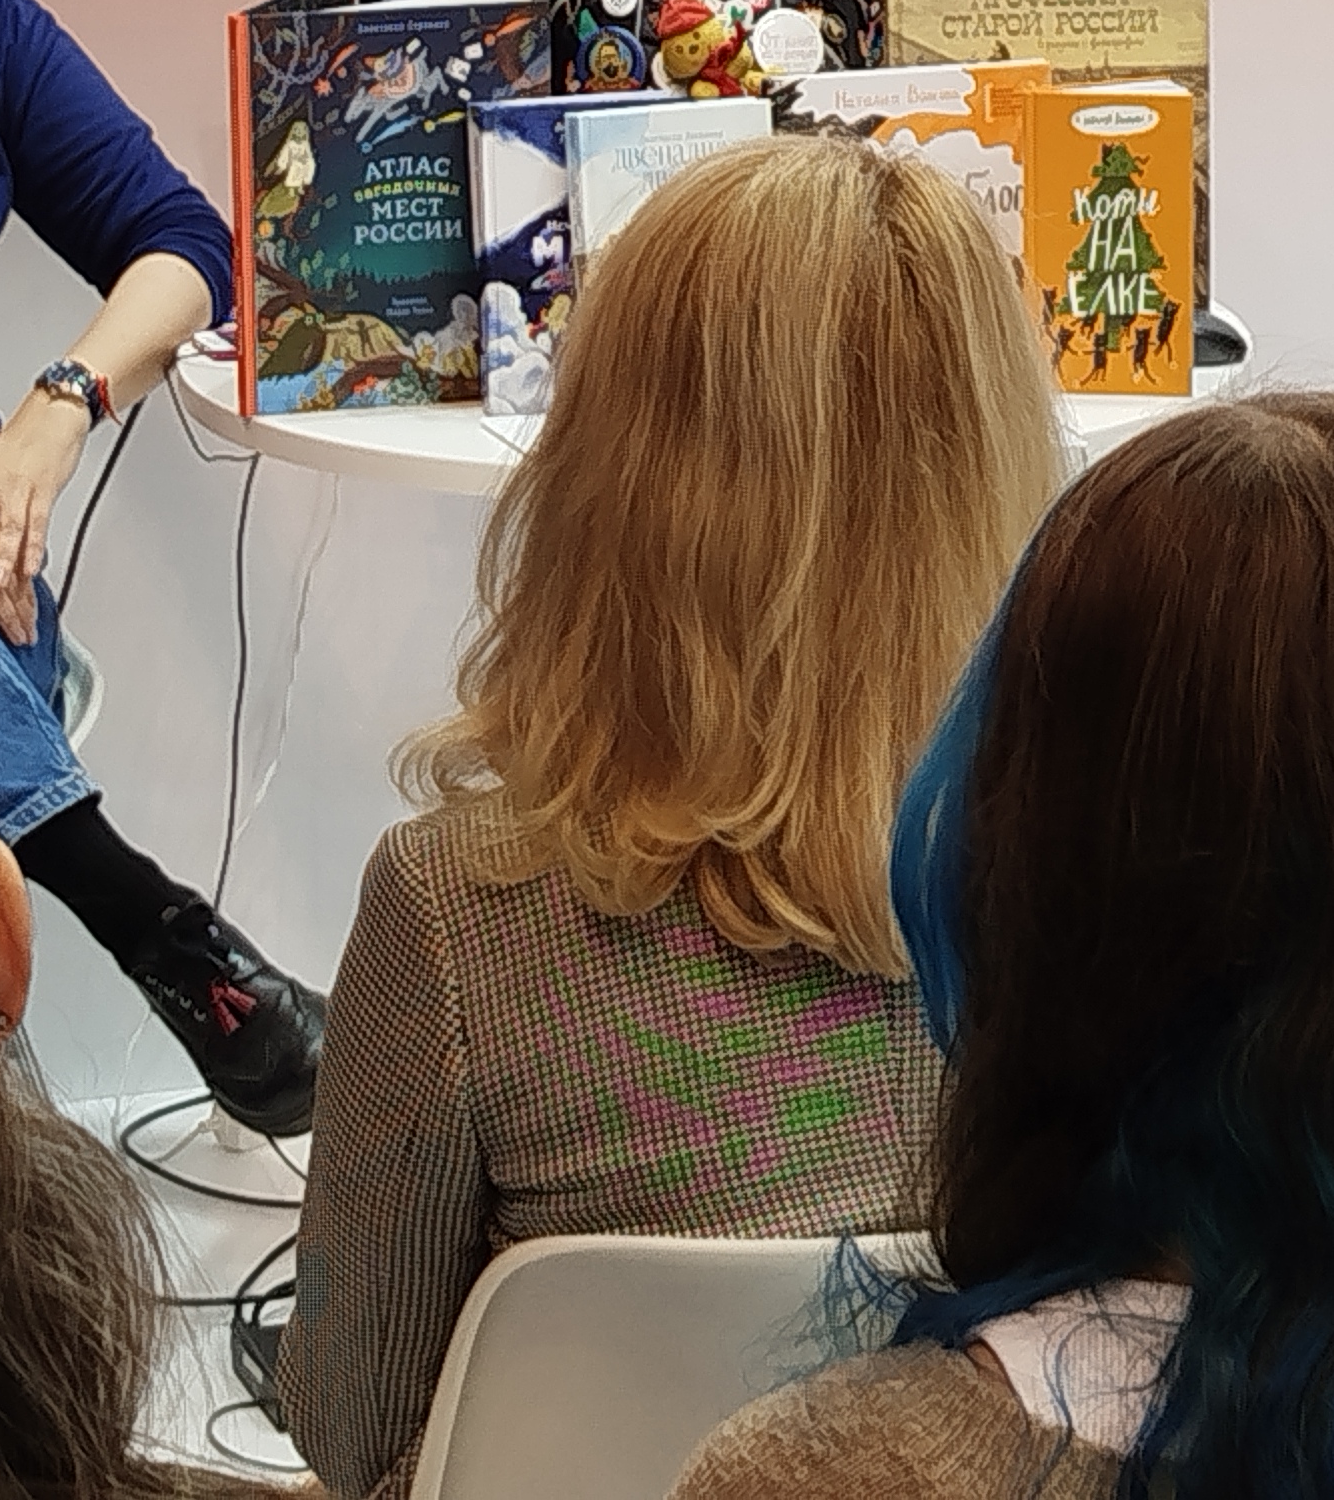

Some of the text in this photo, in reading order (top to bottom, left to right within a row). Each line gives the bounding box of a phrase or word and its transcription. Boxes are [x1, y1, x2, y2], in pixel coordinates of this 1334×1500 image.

[941, 9, 1159, 39] СТАРОЙ РОССИИ
[364, 155, 452, 183] АТЛАС
[371, 197, 444, 222] МЕСТ
[353, 218, 464, 246] РОССИИ
[1088, 213, 1138, 273] НА
